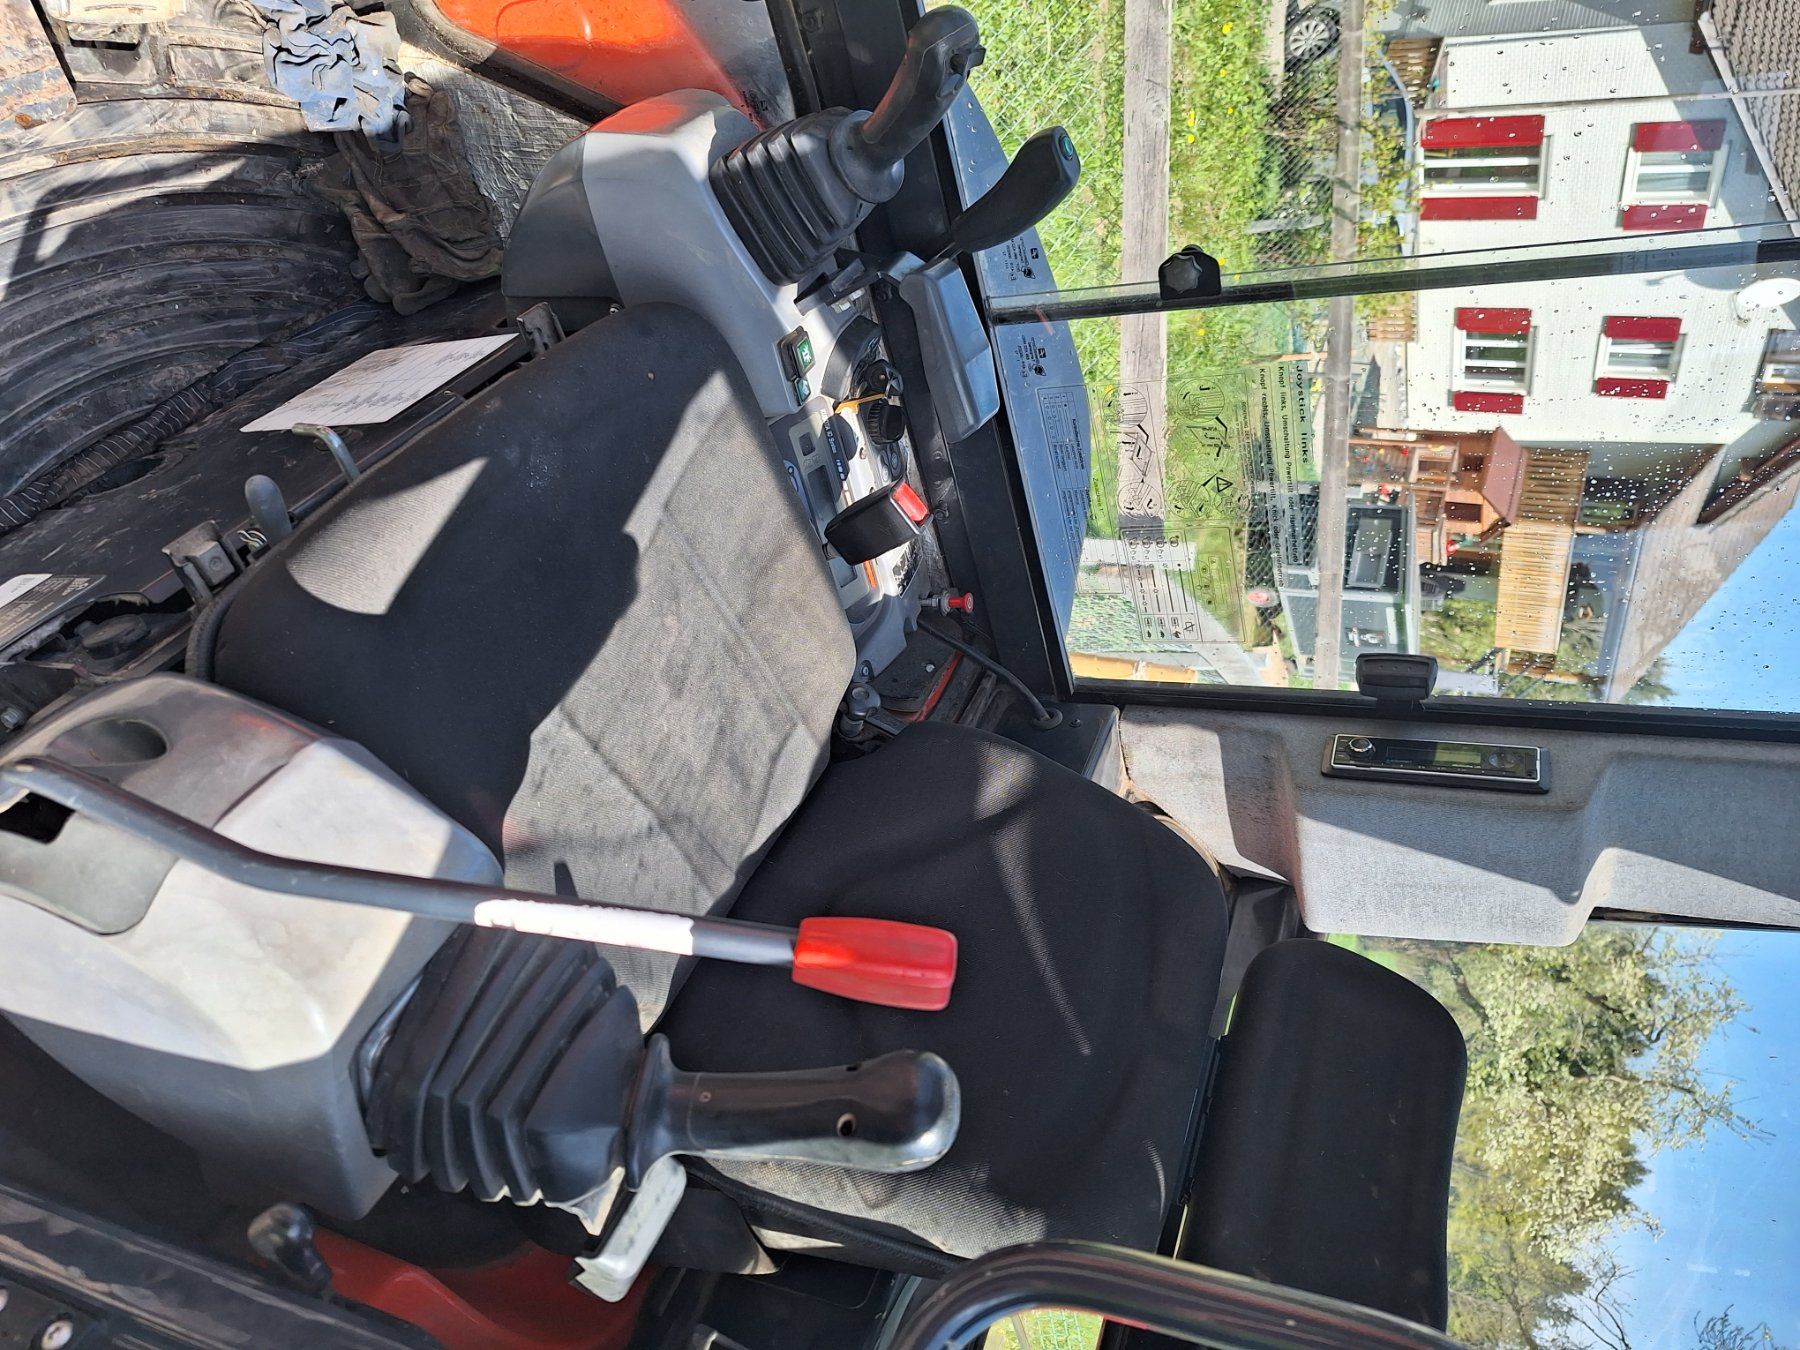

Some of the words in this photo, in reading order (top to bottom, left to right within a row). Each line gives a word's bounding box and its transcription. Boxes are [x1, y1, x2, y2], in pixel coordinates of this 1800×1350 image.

[1278, 366, 1286, 388] Knopf
[1282, 414, 1291, 458] Umschaltung
[1296, 365, 1306, 423] Joystick
[1301, 432, 1309, 464] links
[1264, 421, 1274, 465] Umschaltung
[1286, 462, 1296, 493] Powertilt
[1290, 514, 1299, 563] Hammerbetrieb
